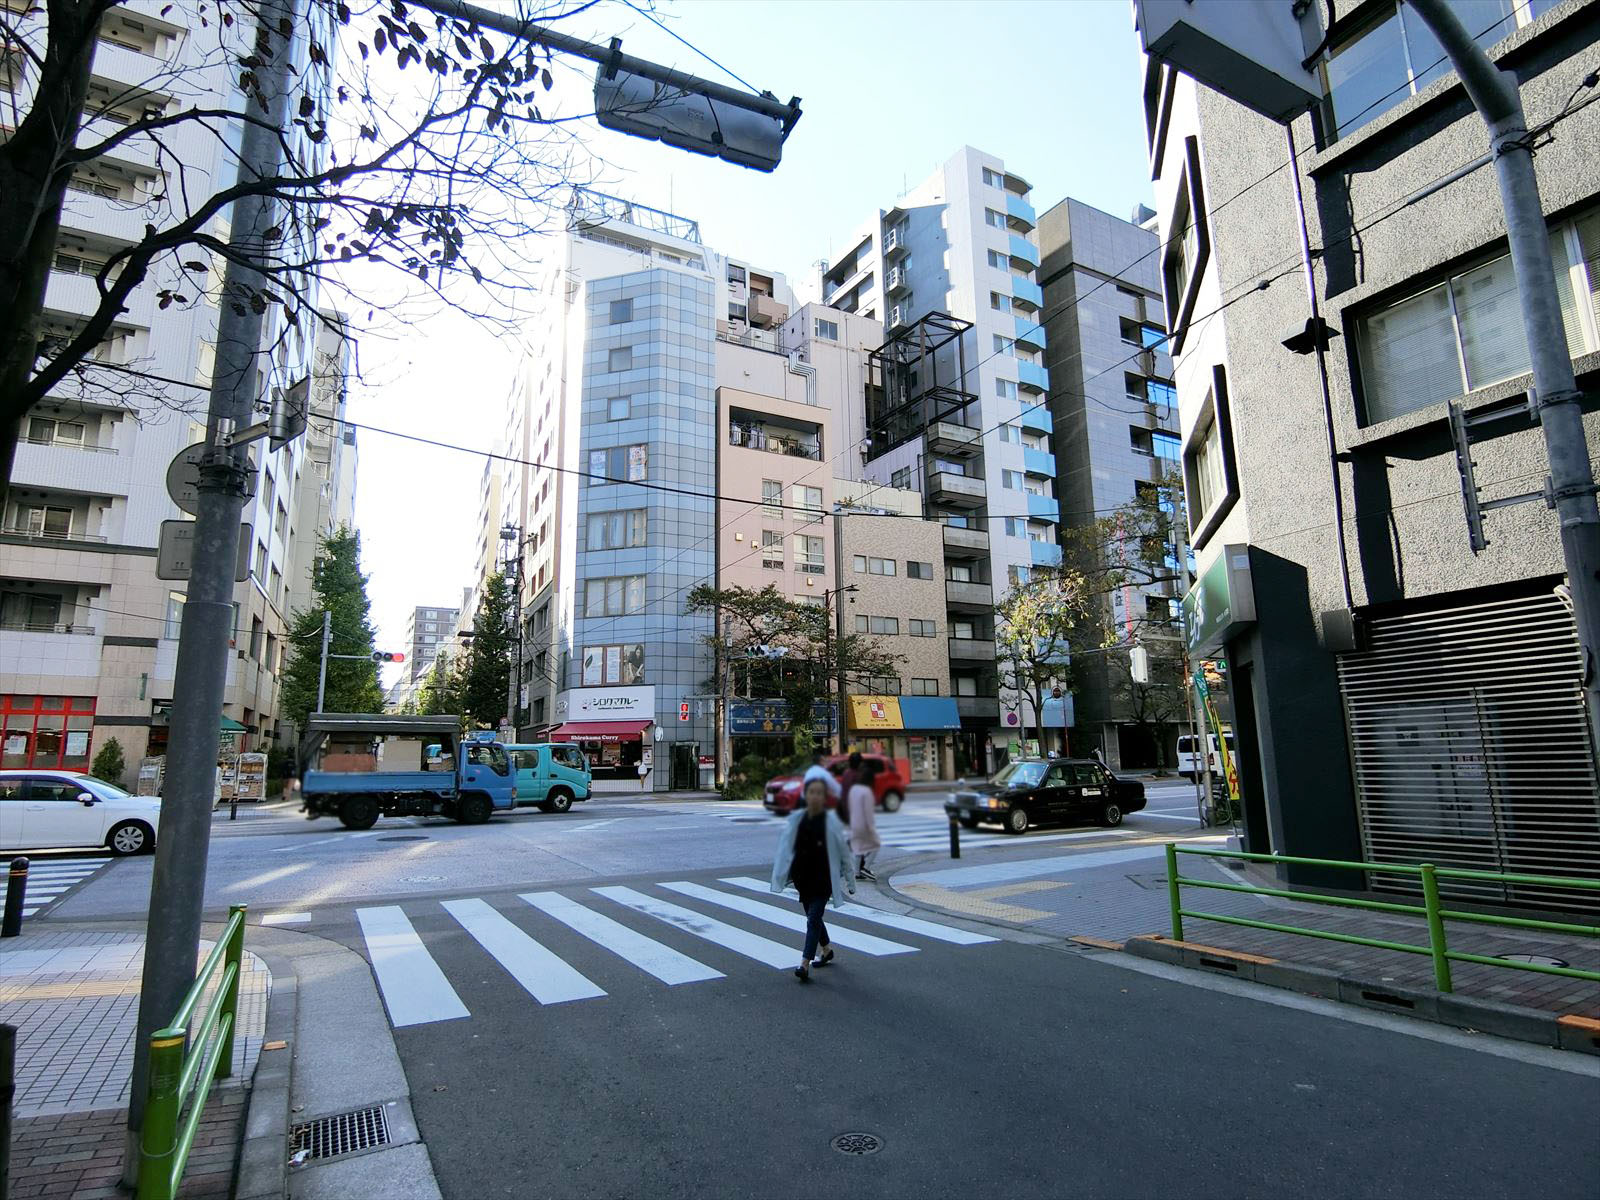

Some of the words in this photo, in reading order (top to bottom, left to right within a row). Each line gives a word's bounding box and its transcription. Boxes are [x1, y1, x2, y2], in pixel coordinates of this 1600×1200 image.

[593, 697, 639, 706] シロクマカレー
